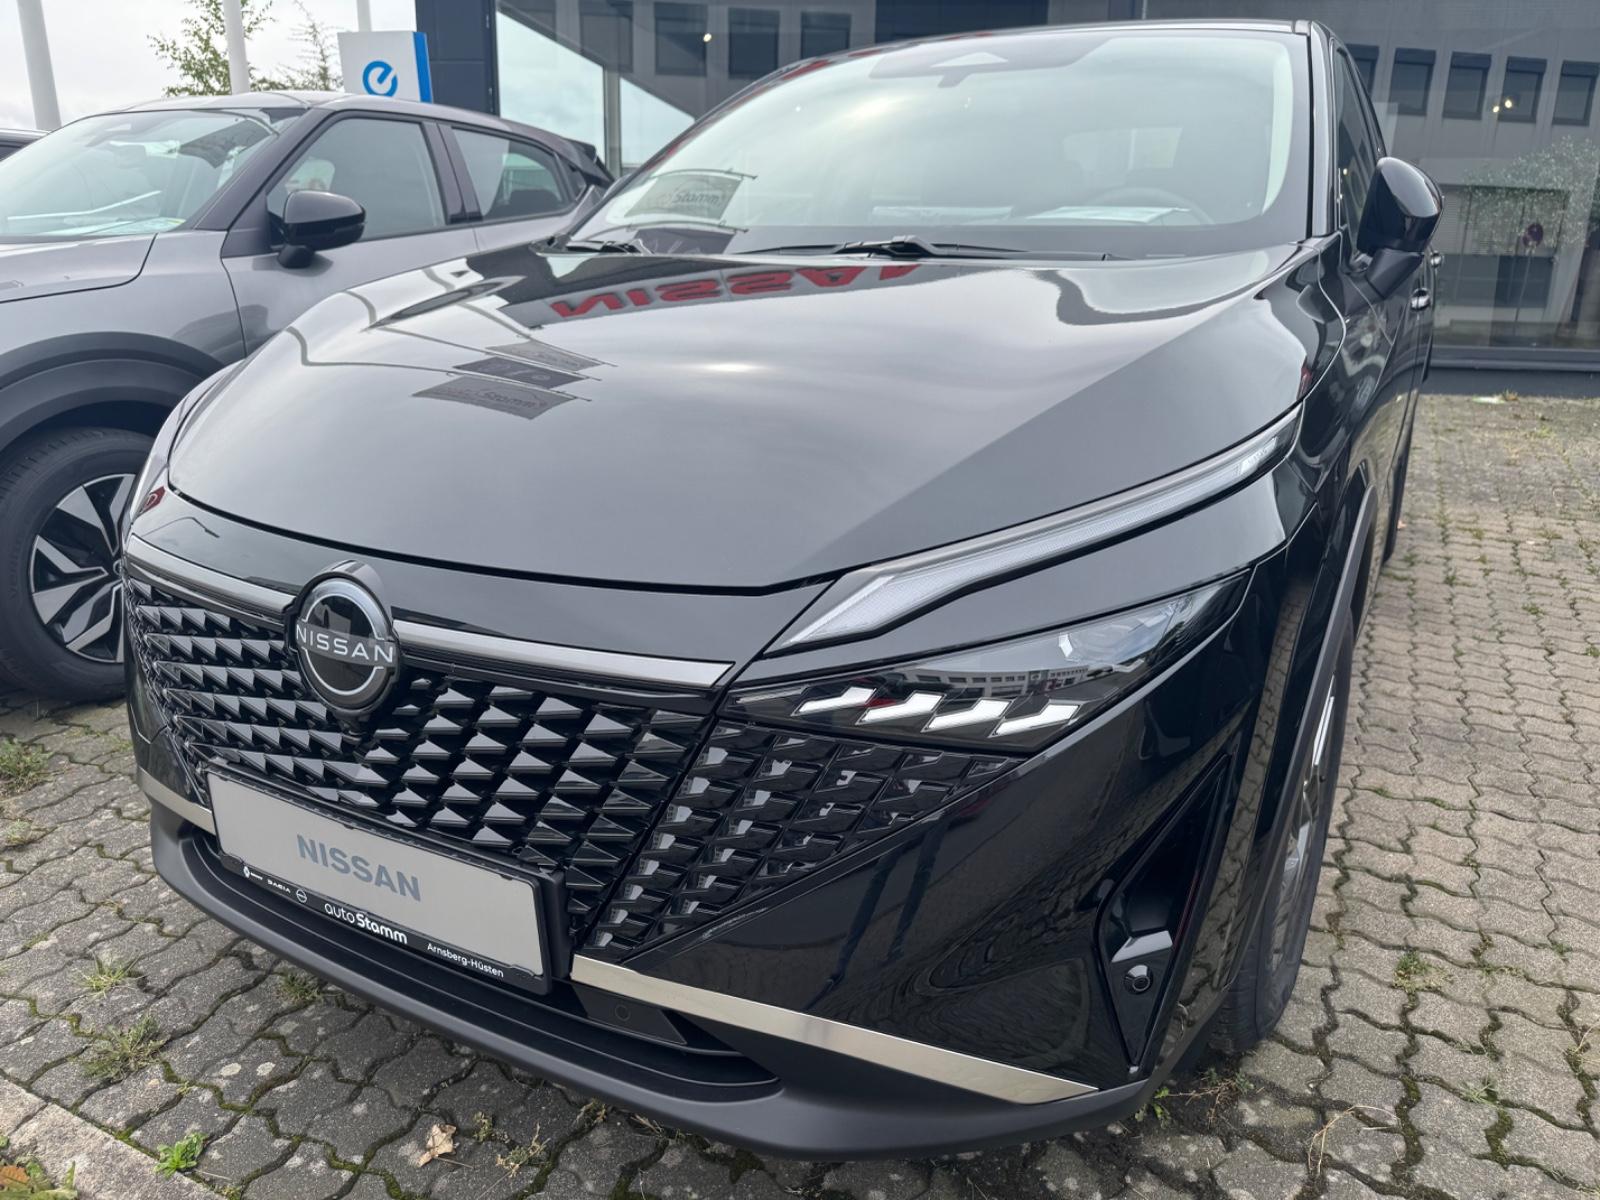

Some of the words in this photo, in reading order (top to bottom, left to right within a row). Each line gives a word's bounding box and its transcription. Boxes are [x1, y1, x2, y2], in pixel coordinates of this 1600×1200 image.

[296, 624, 393, 663] NISSAN
[297, 833, 421, 902] NISSAN
[427, 942, 504, 978] Arnsberg-Hüsten
